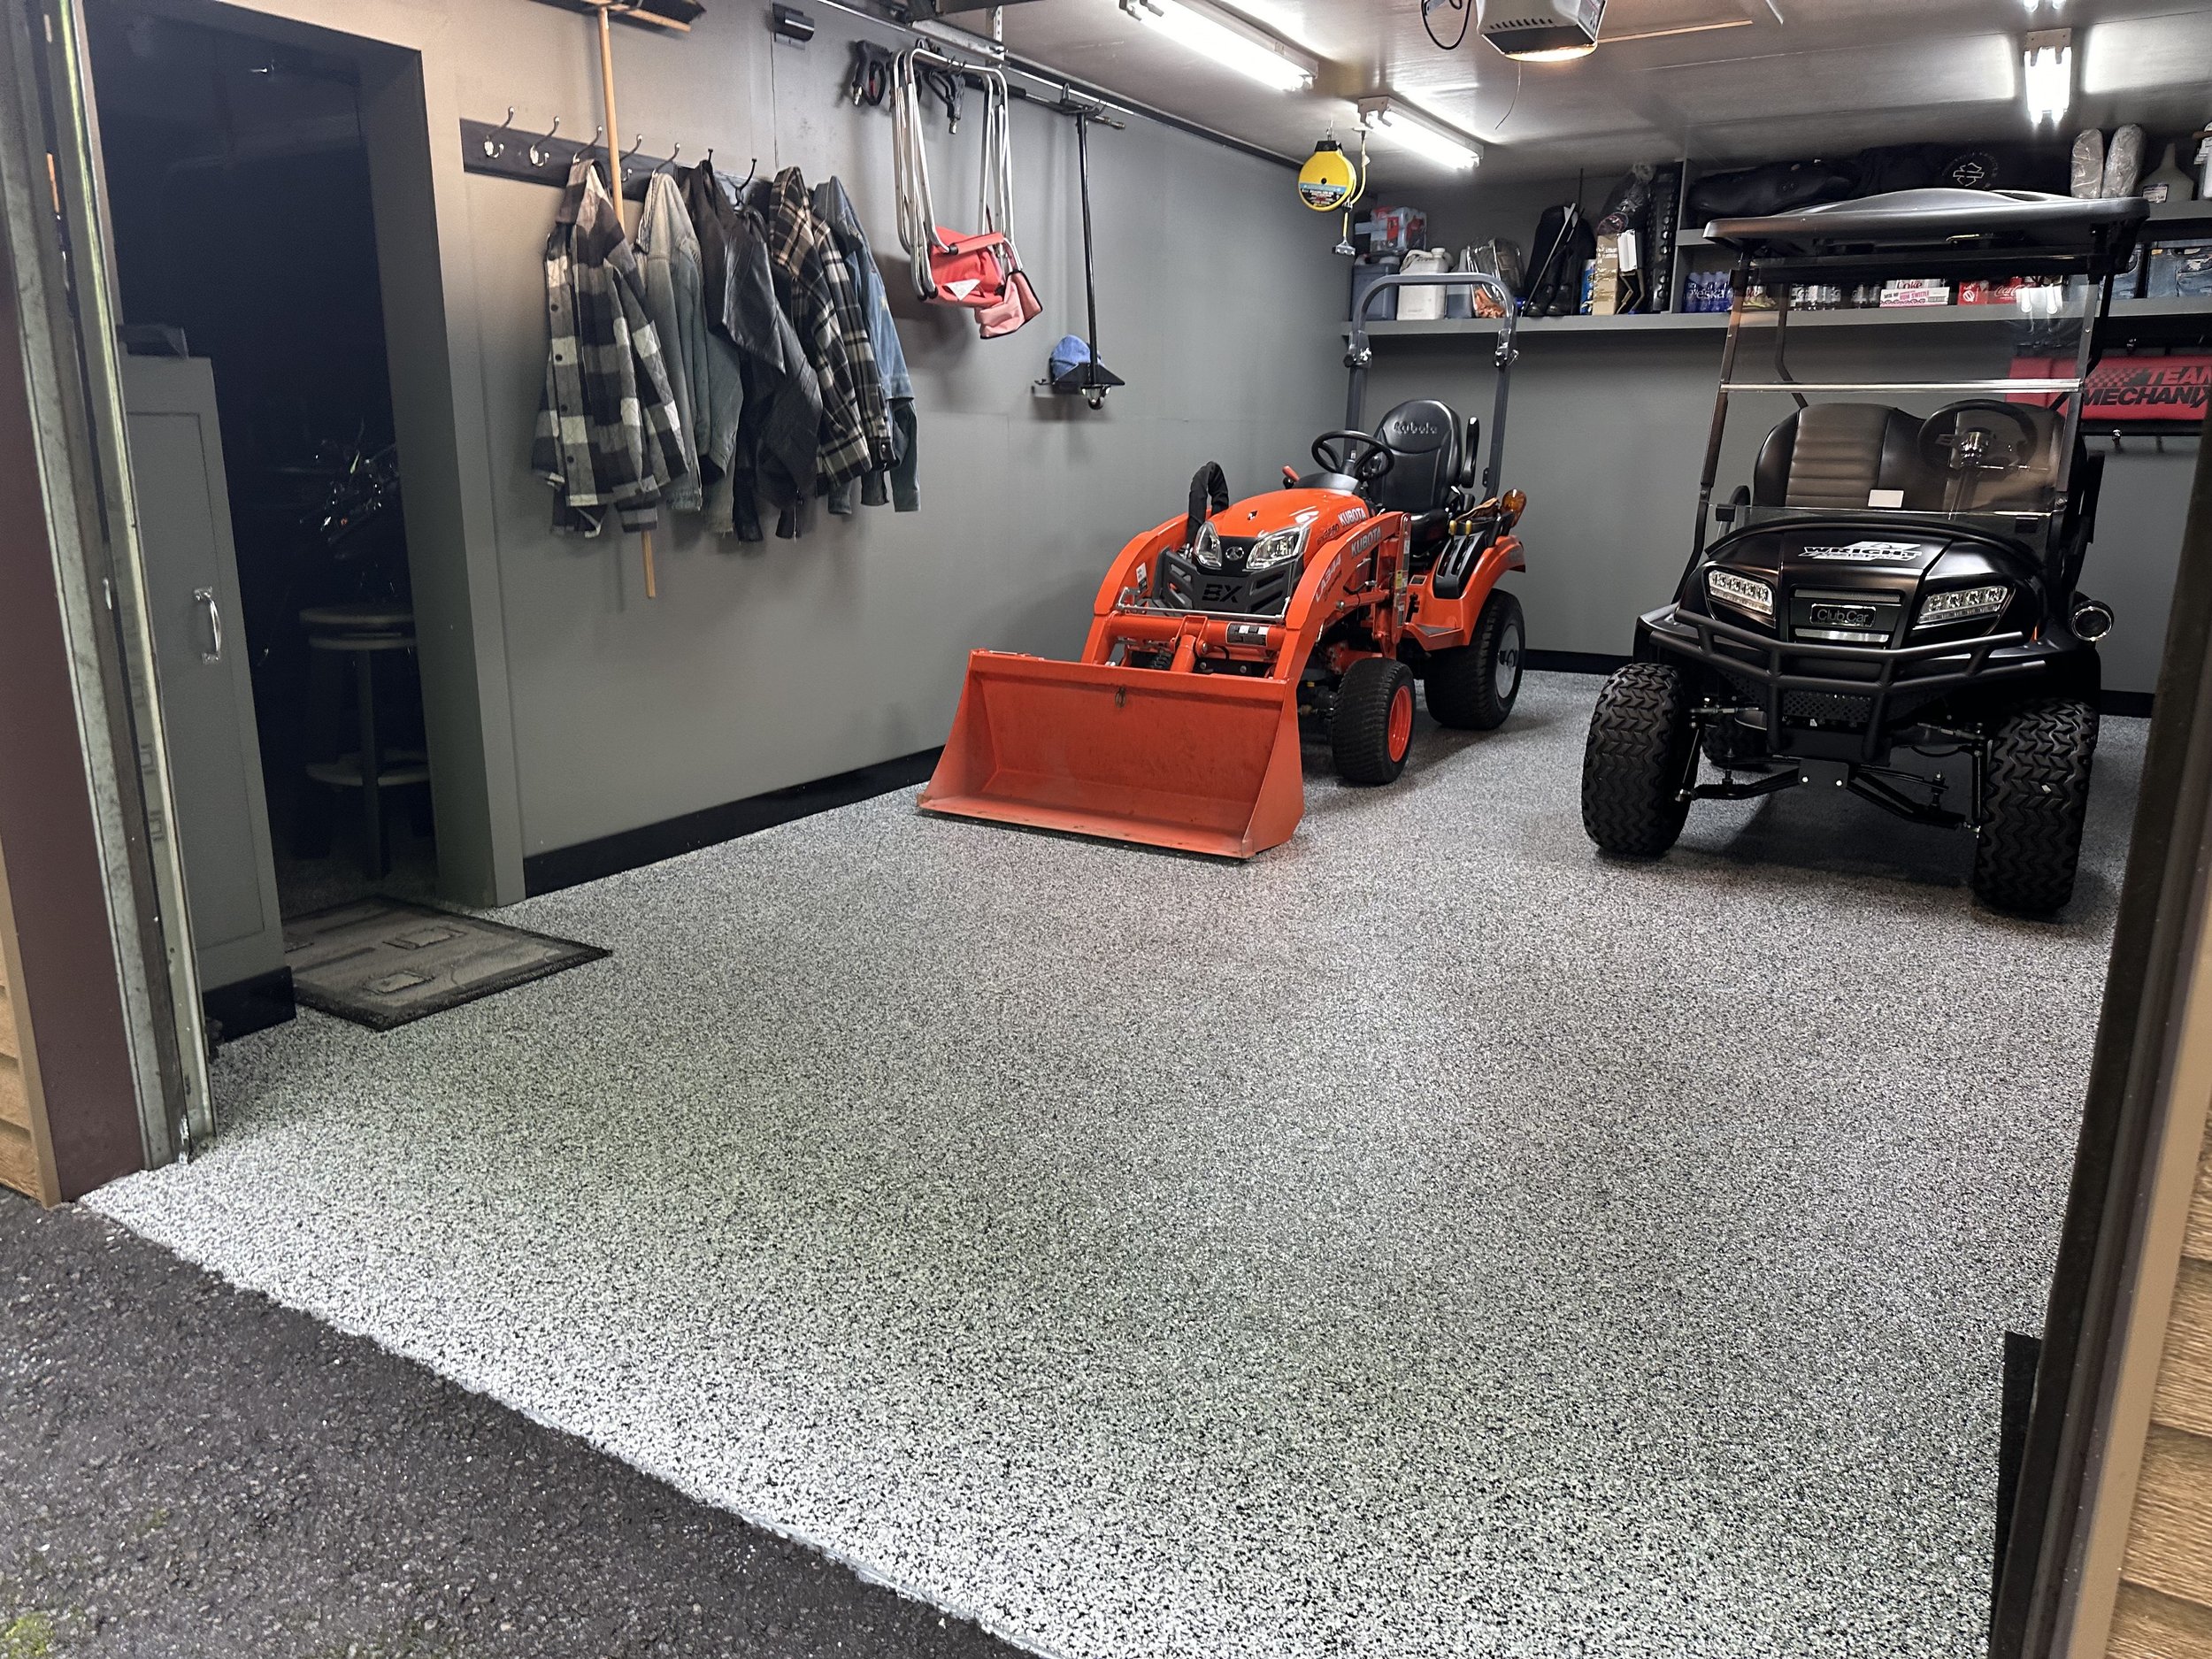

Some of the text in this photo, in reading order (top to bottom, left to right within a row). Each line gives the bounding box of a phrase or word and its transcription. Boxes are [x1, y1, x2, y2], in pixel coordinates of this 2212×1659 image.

[1393, 420, 1438, 434] Kubota
[1338, 507, 1366, 526] KUBOTA
[1351, 526, 1381, 557] KUBOTA
[1804, 546, 1923, 558] WRIGHT
[1202, 584, 1243, 603] BX
[1817, 609, 1870, 624] Club Car
